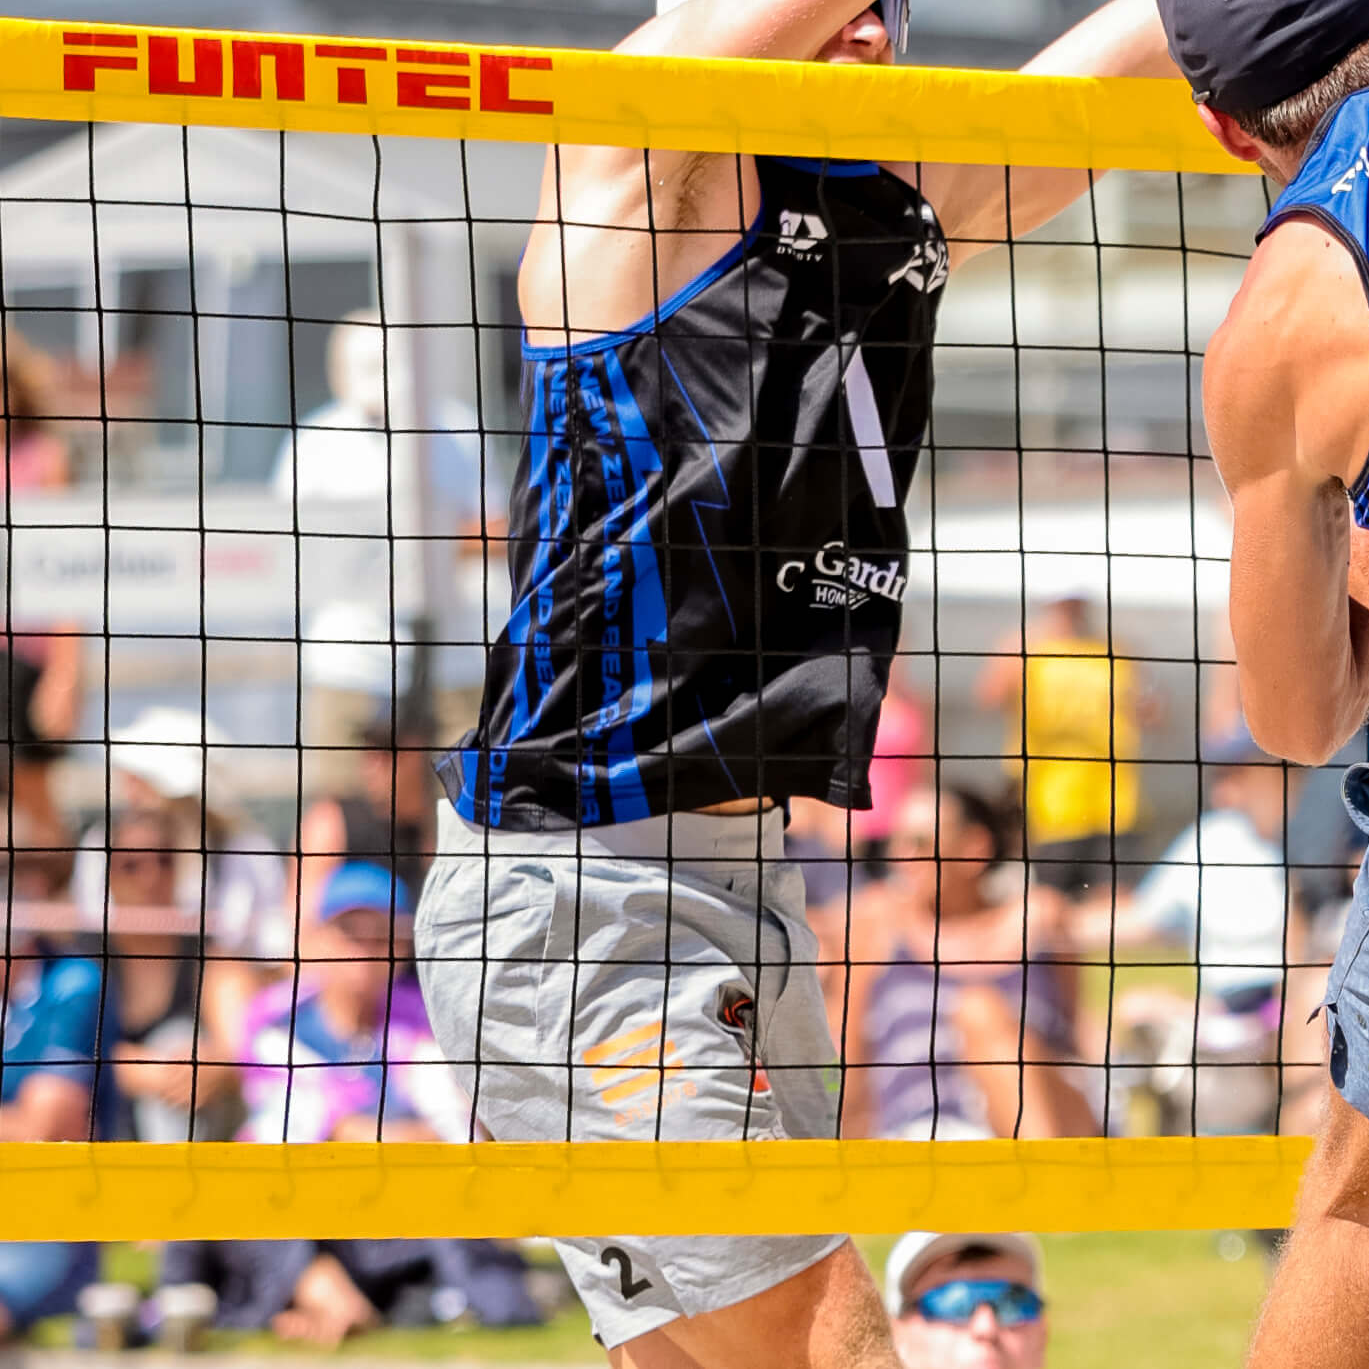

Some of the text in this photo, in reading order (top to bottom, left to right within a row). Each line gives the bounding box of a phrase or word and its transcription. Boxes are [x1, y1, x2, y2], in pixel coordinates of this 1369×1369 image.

[63, 31, 554, 115] FUNTEC
[576, 357, 616, 447] NEW
[601, 1246, 653, 1300] 2
